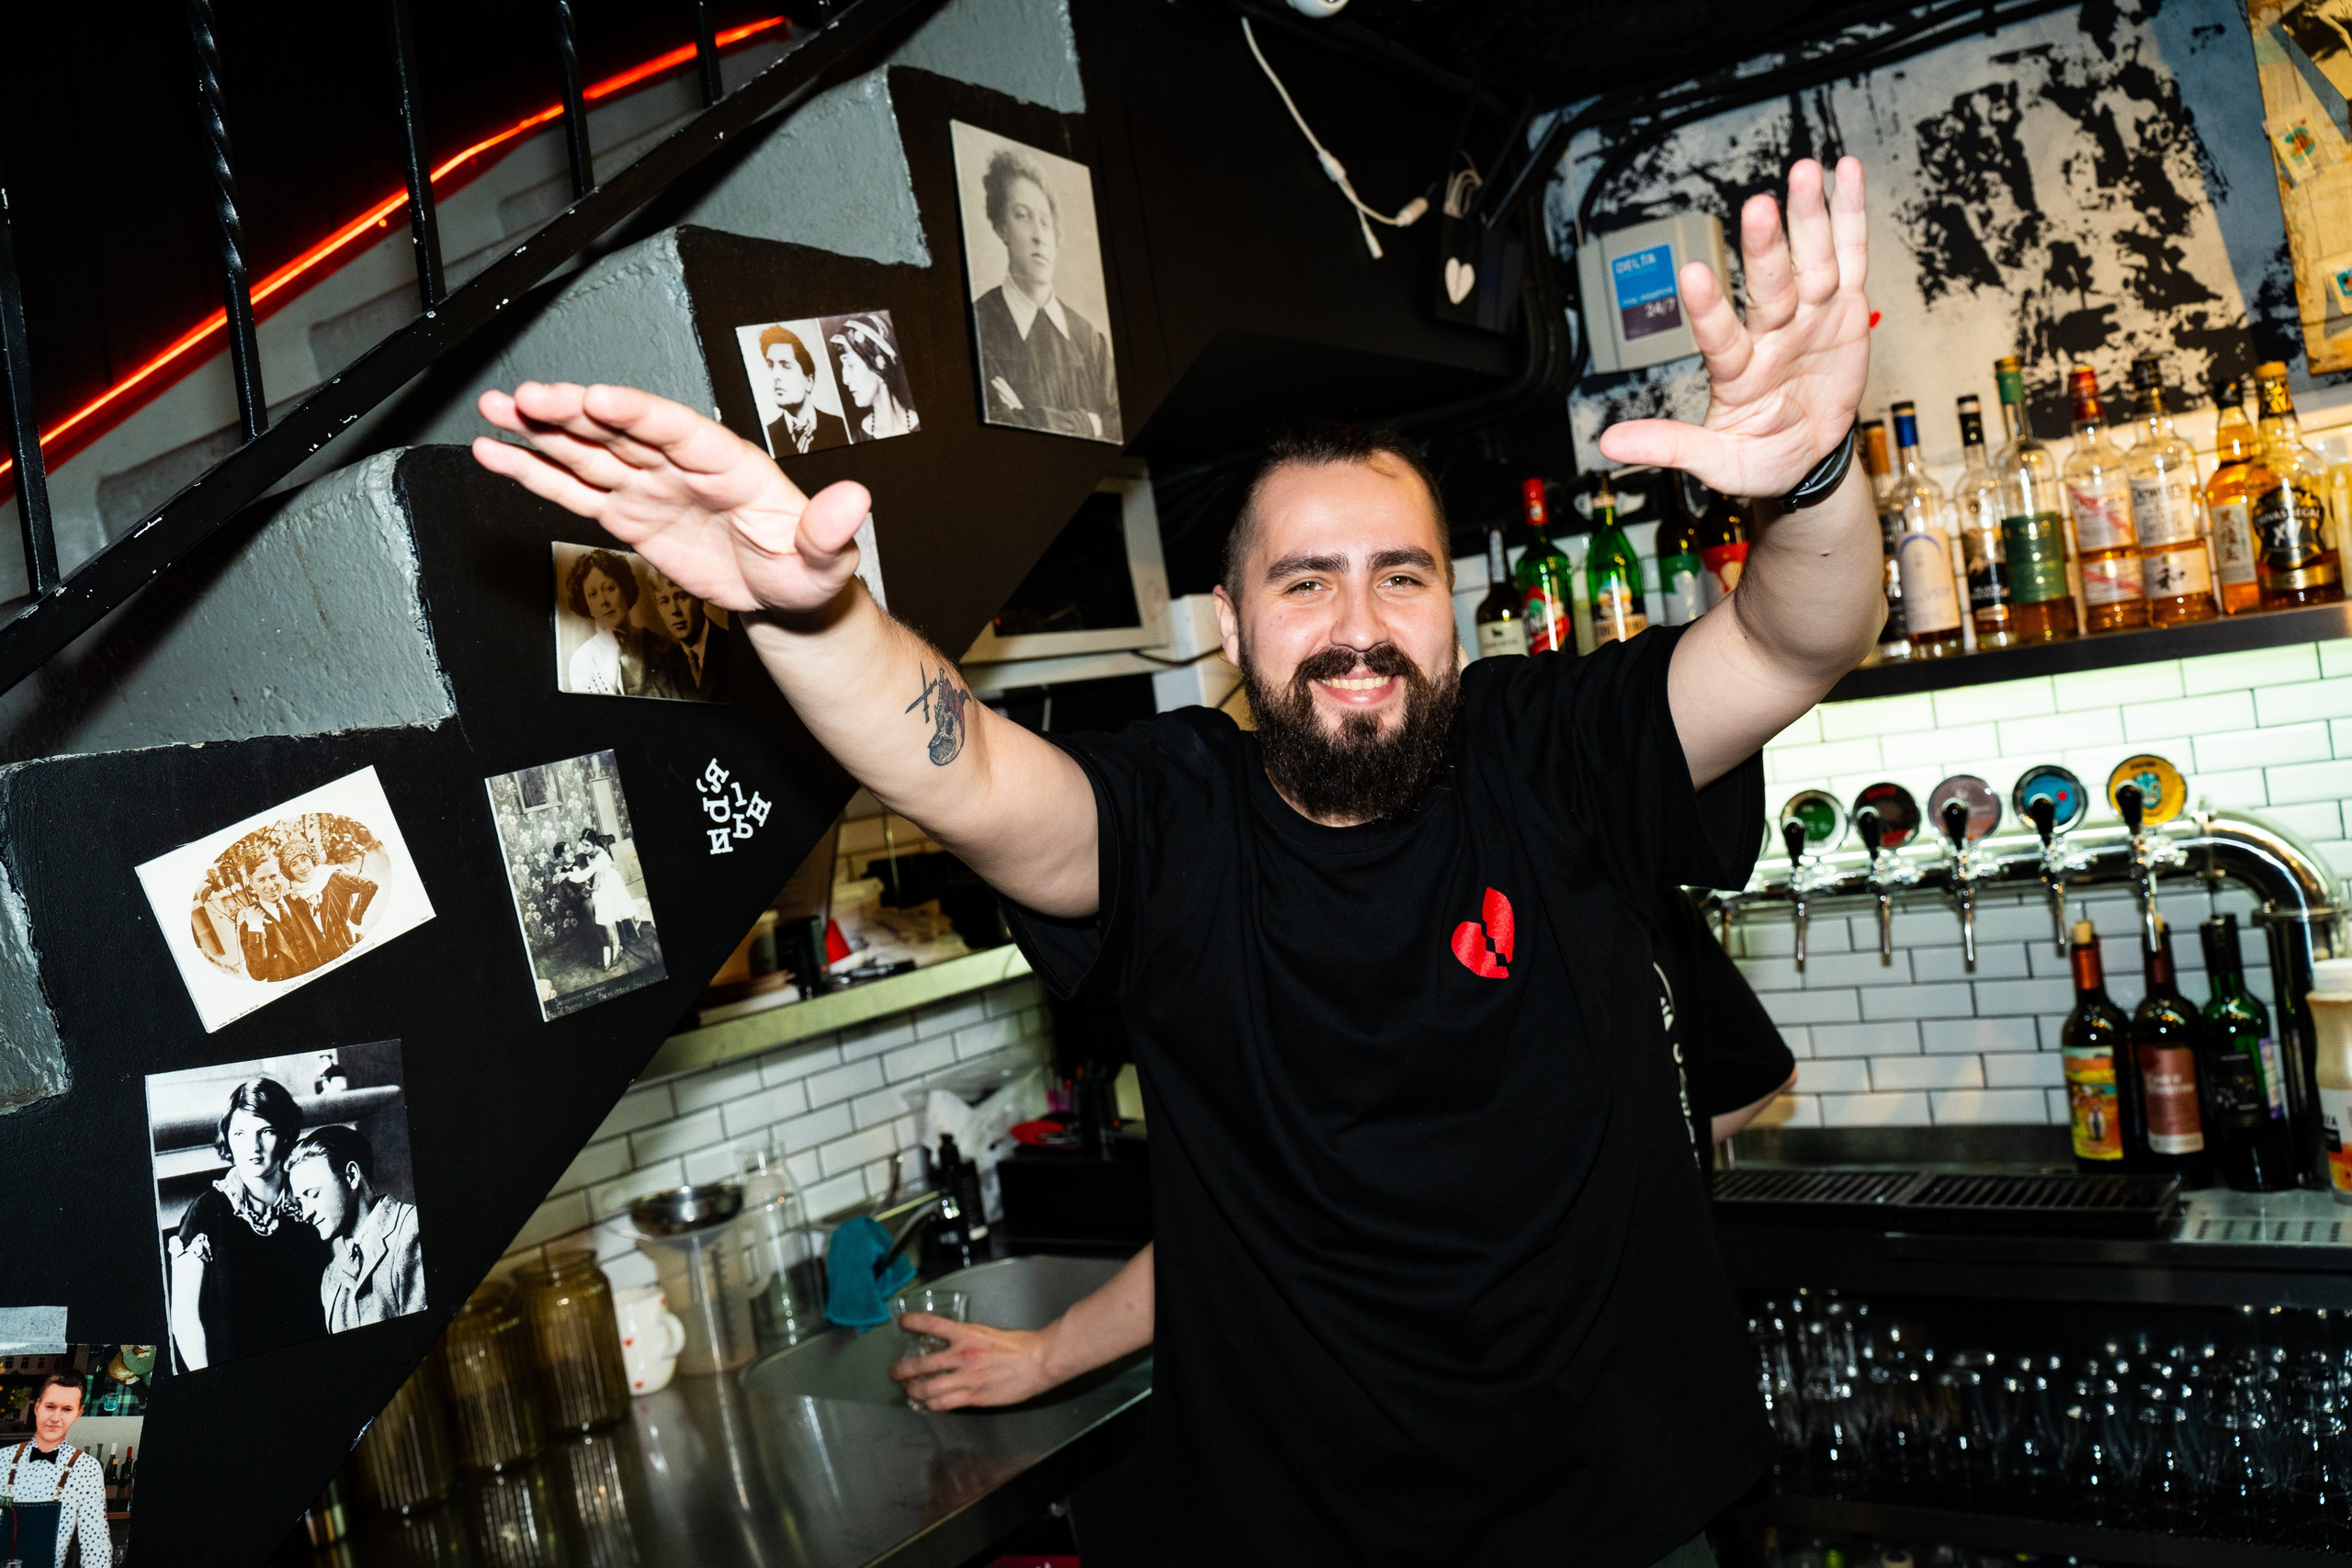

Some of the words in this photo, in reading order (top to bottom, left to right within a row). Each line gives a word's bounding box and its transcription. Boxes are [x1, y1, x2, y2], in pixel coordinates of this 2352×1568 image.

[1615, 254, 1657, 274] DELTA
[1644, 297, 1678, 319] 24/7
[282, 981, 301, 993] Charly
[303, 967, 325, 982] Chaplin
[334, 955, 349, 965] Anna
